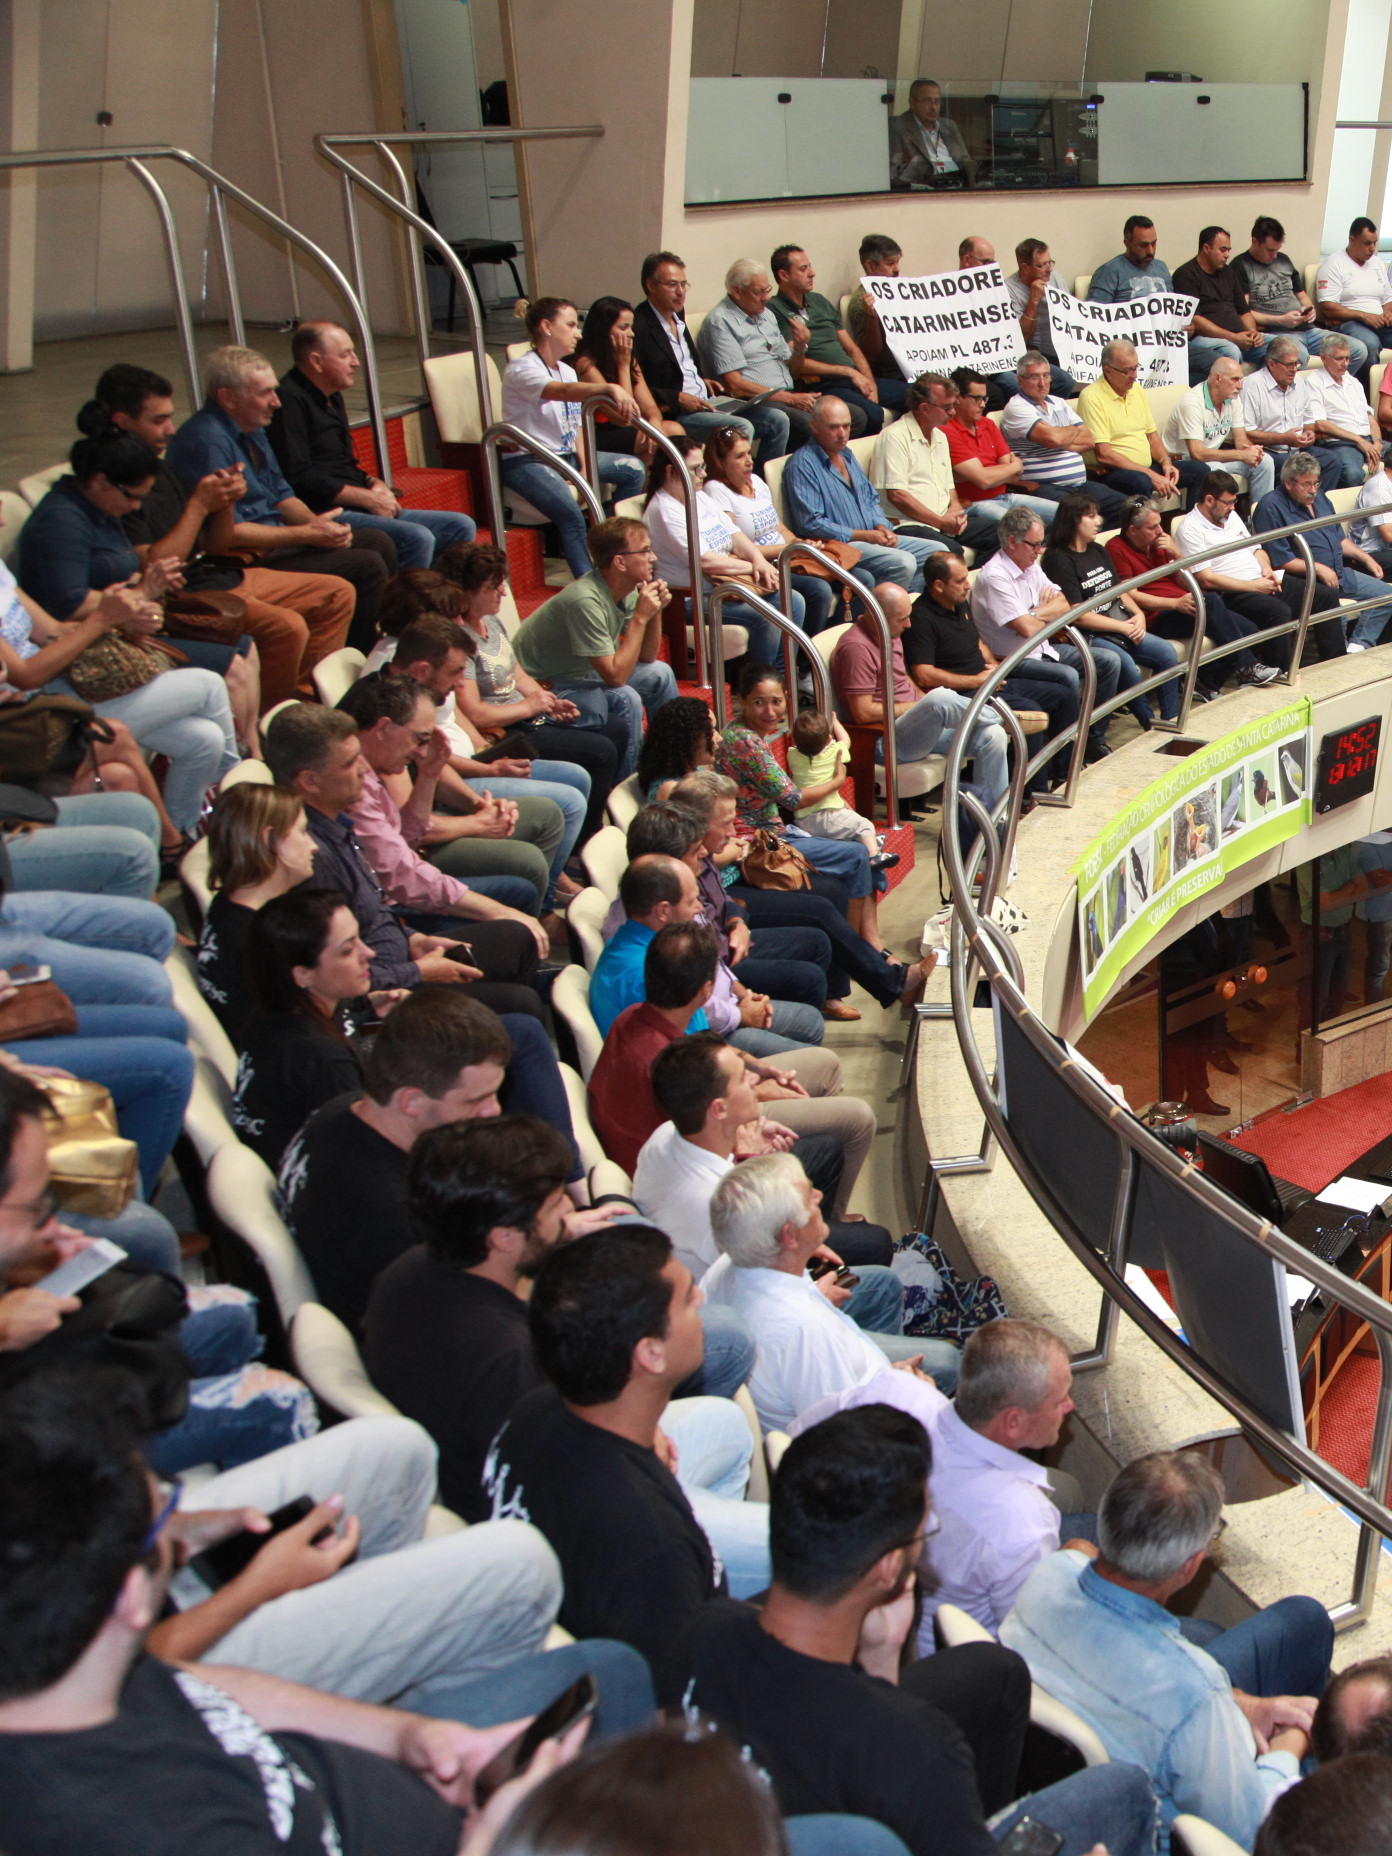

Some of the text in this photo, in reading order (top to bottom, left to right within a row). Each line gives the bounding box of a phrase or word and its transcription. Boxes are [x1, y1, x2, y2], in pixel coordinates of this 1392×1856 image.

[871, 281, 895, 300] OS
[1048, 290, 1193, 323] OS CRIADORES
[906, 334, 1014, 362] APOIAM PL 487.3
[1236, 728, 1261, 753] SANTA
[1262, 710, 1300, 743] CATARINA
